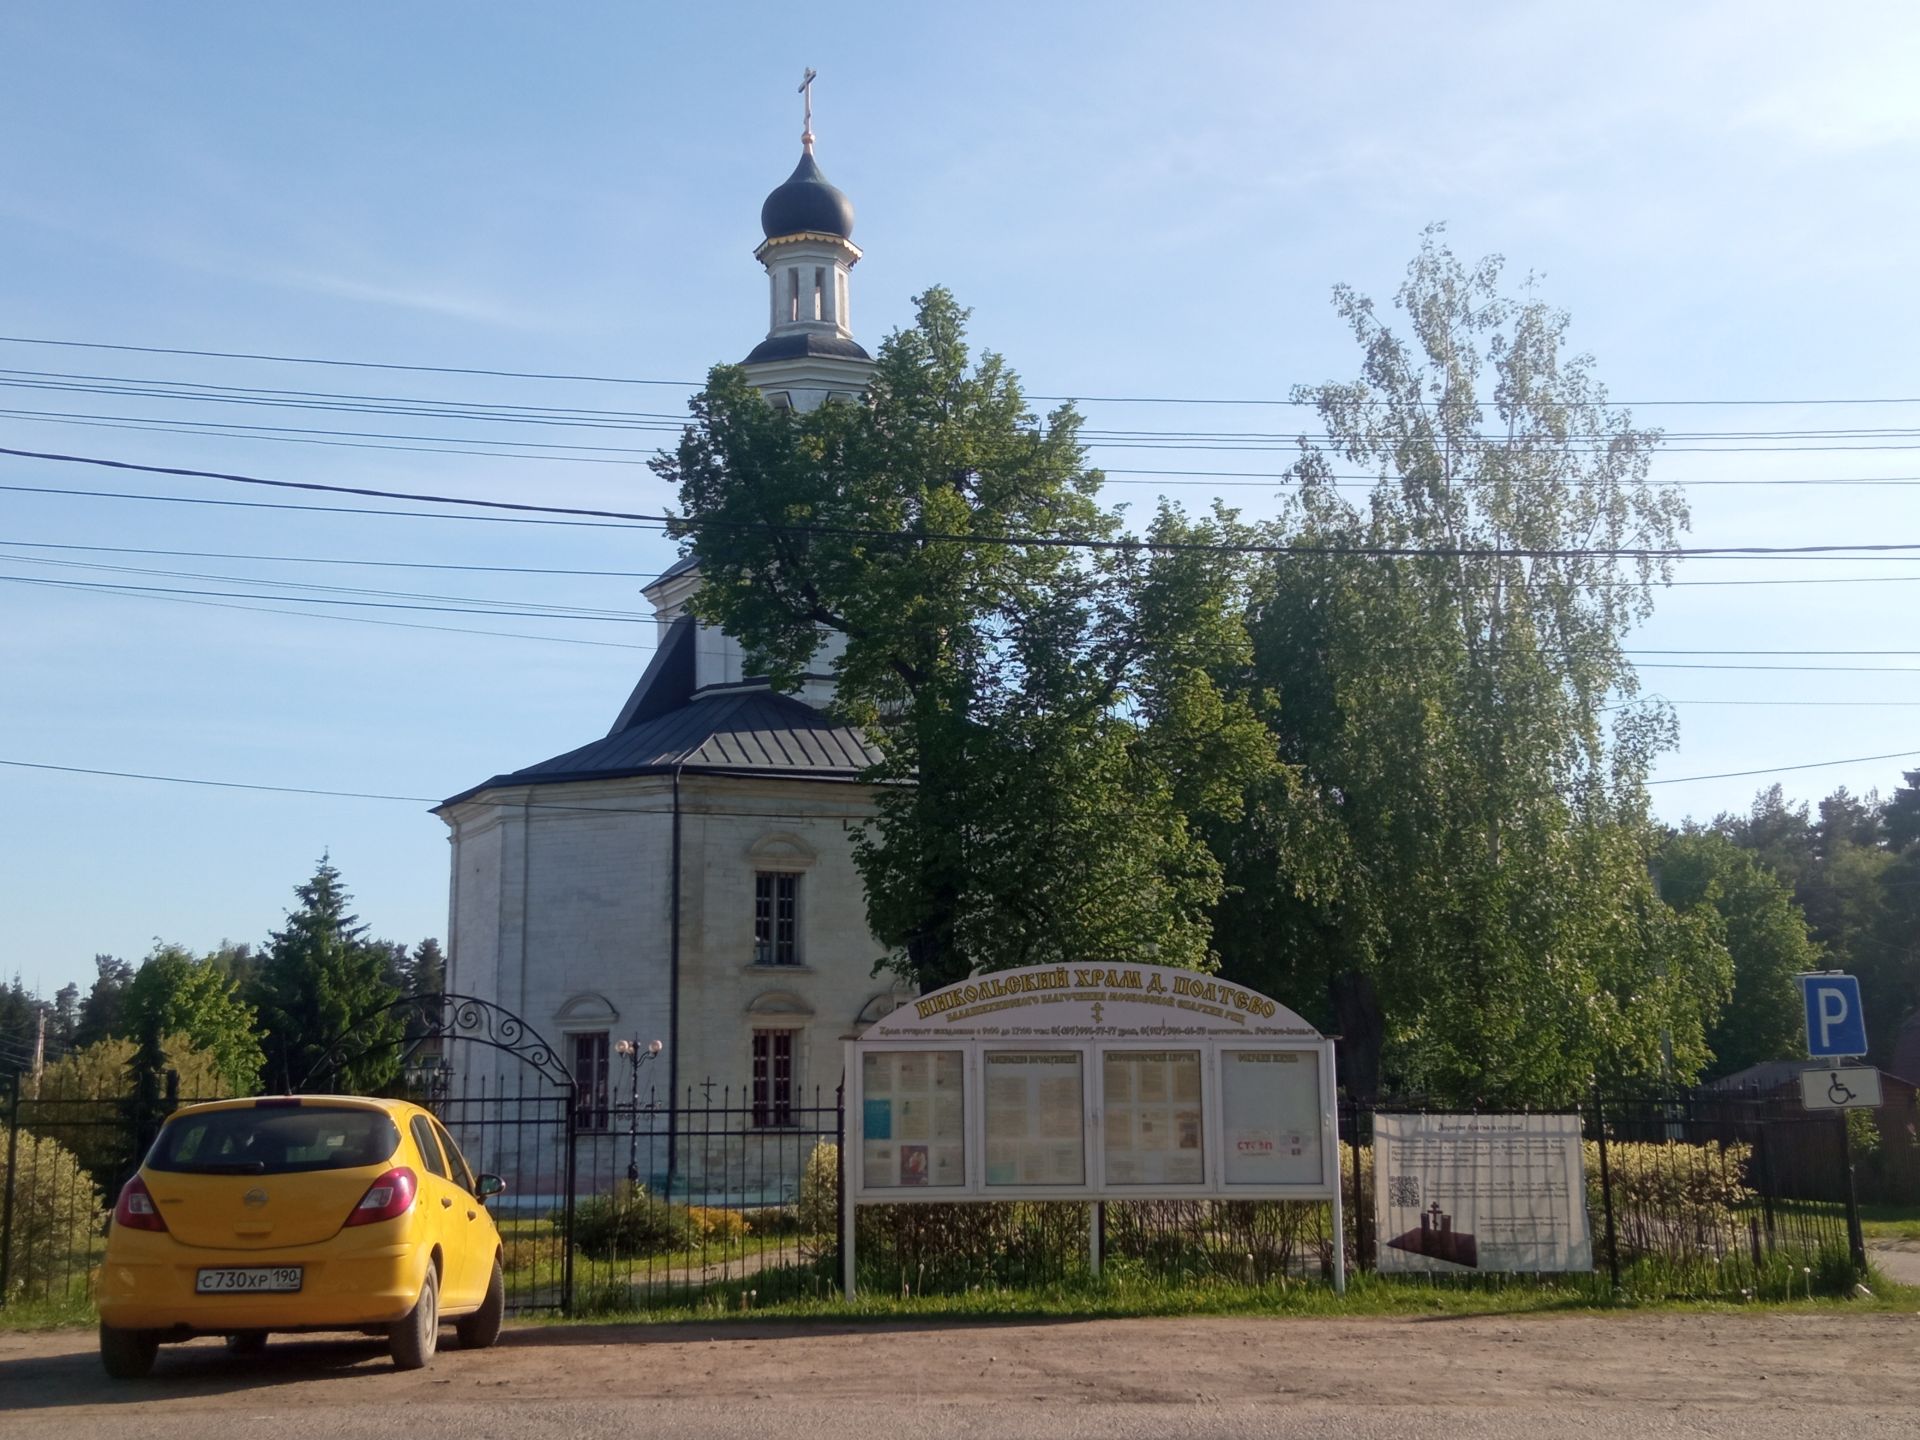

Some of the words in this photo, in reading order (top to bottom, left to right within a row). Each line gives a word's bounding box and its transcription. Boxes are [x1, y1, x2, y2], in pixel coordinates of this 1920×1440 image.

[914, 967, 1070, 1020] НИКОЛЬСКИЙ
[1074, 969, 1143, 989] ХРАМ
[1146, 973, 1168, 994] Д.
[1172, 976, 1276, 1019] ПОЛТЕВО
[1817, 988, 1848, 1048] P
[272, 1270, 297, 1282] 190
